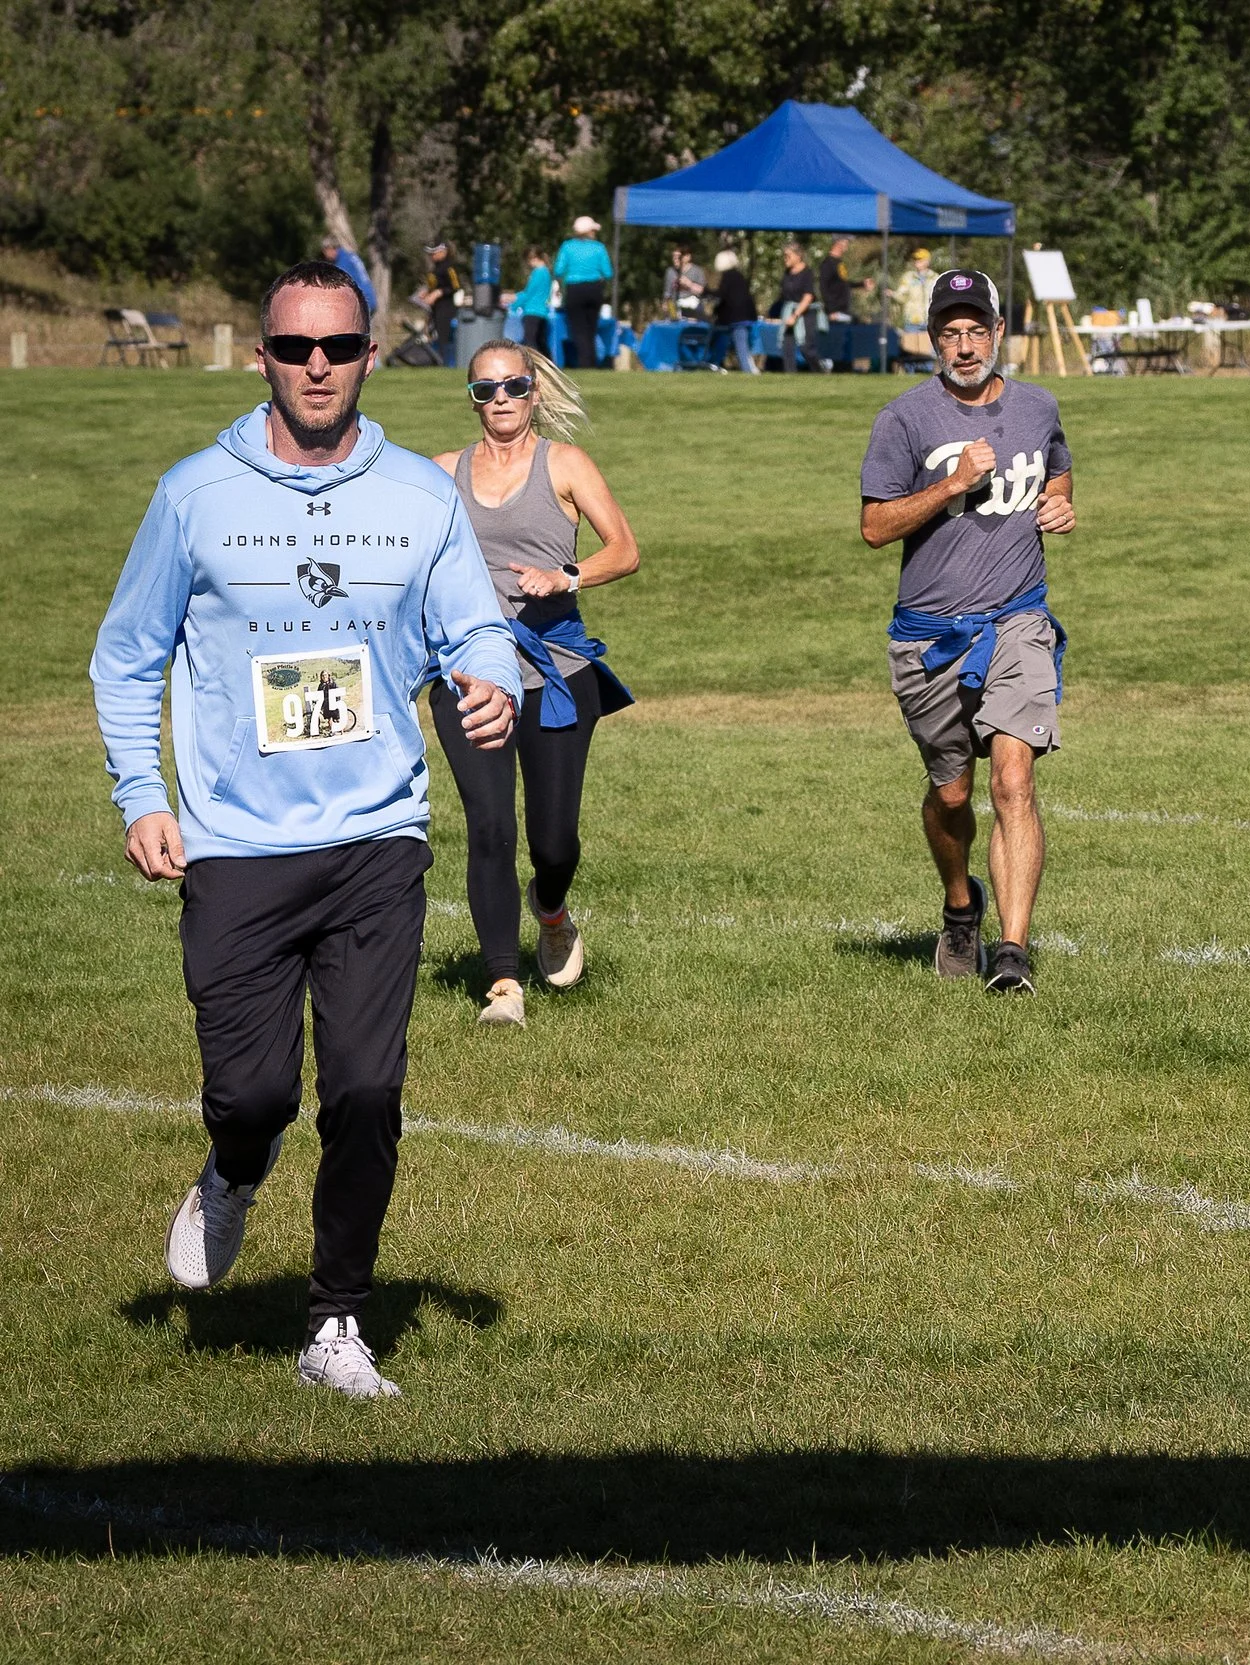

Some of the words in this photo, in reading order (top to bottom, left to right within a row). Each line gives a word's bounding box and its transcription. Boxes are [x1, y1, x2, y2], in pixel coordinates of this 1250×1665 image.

[222, 535, 297, 547] JOHNS
[313, 534, 410, 548] HOPKINS
[249, 620, 312, 633] BLUE
[330, 620, 387, 632] JAYS
[282, 686, 349, 738] 975
